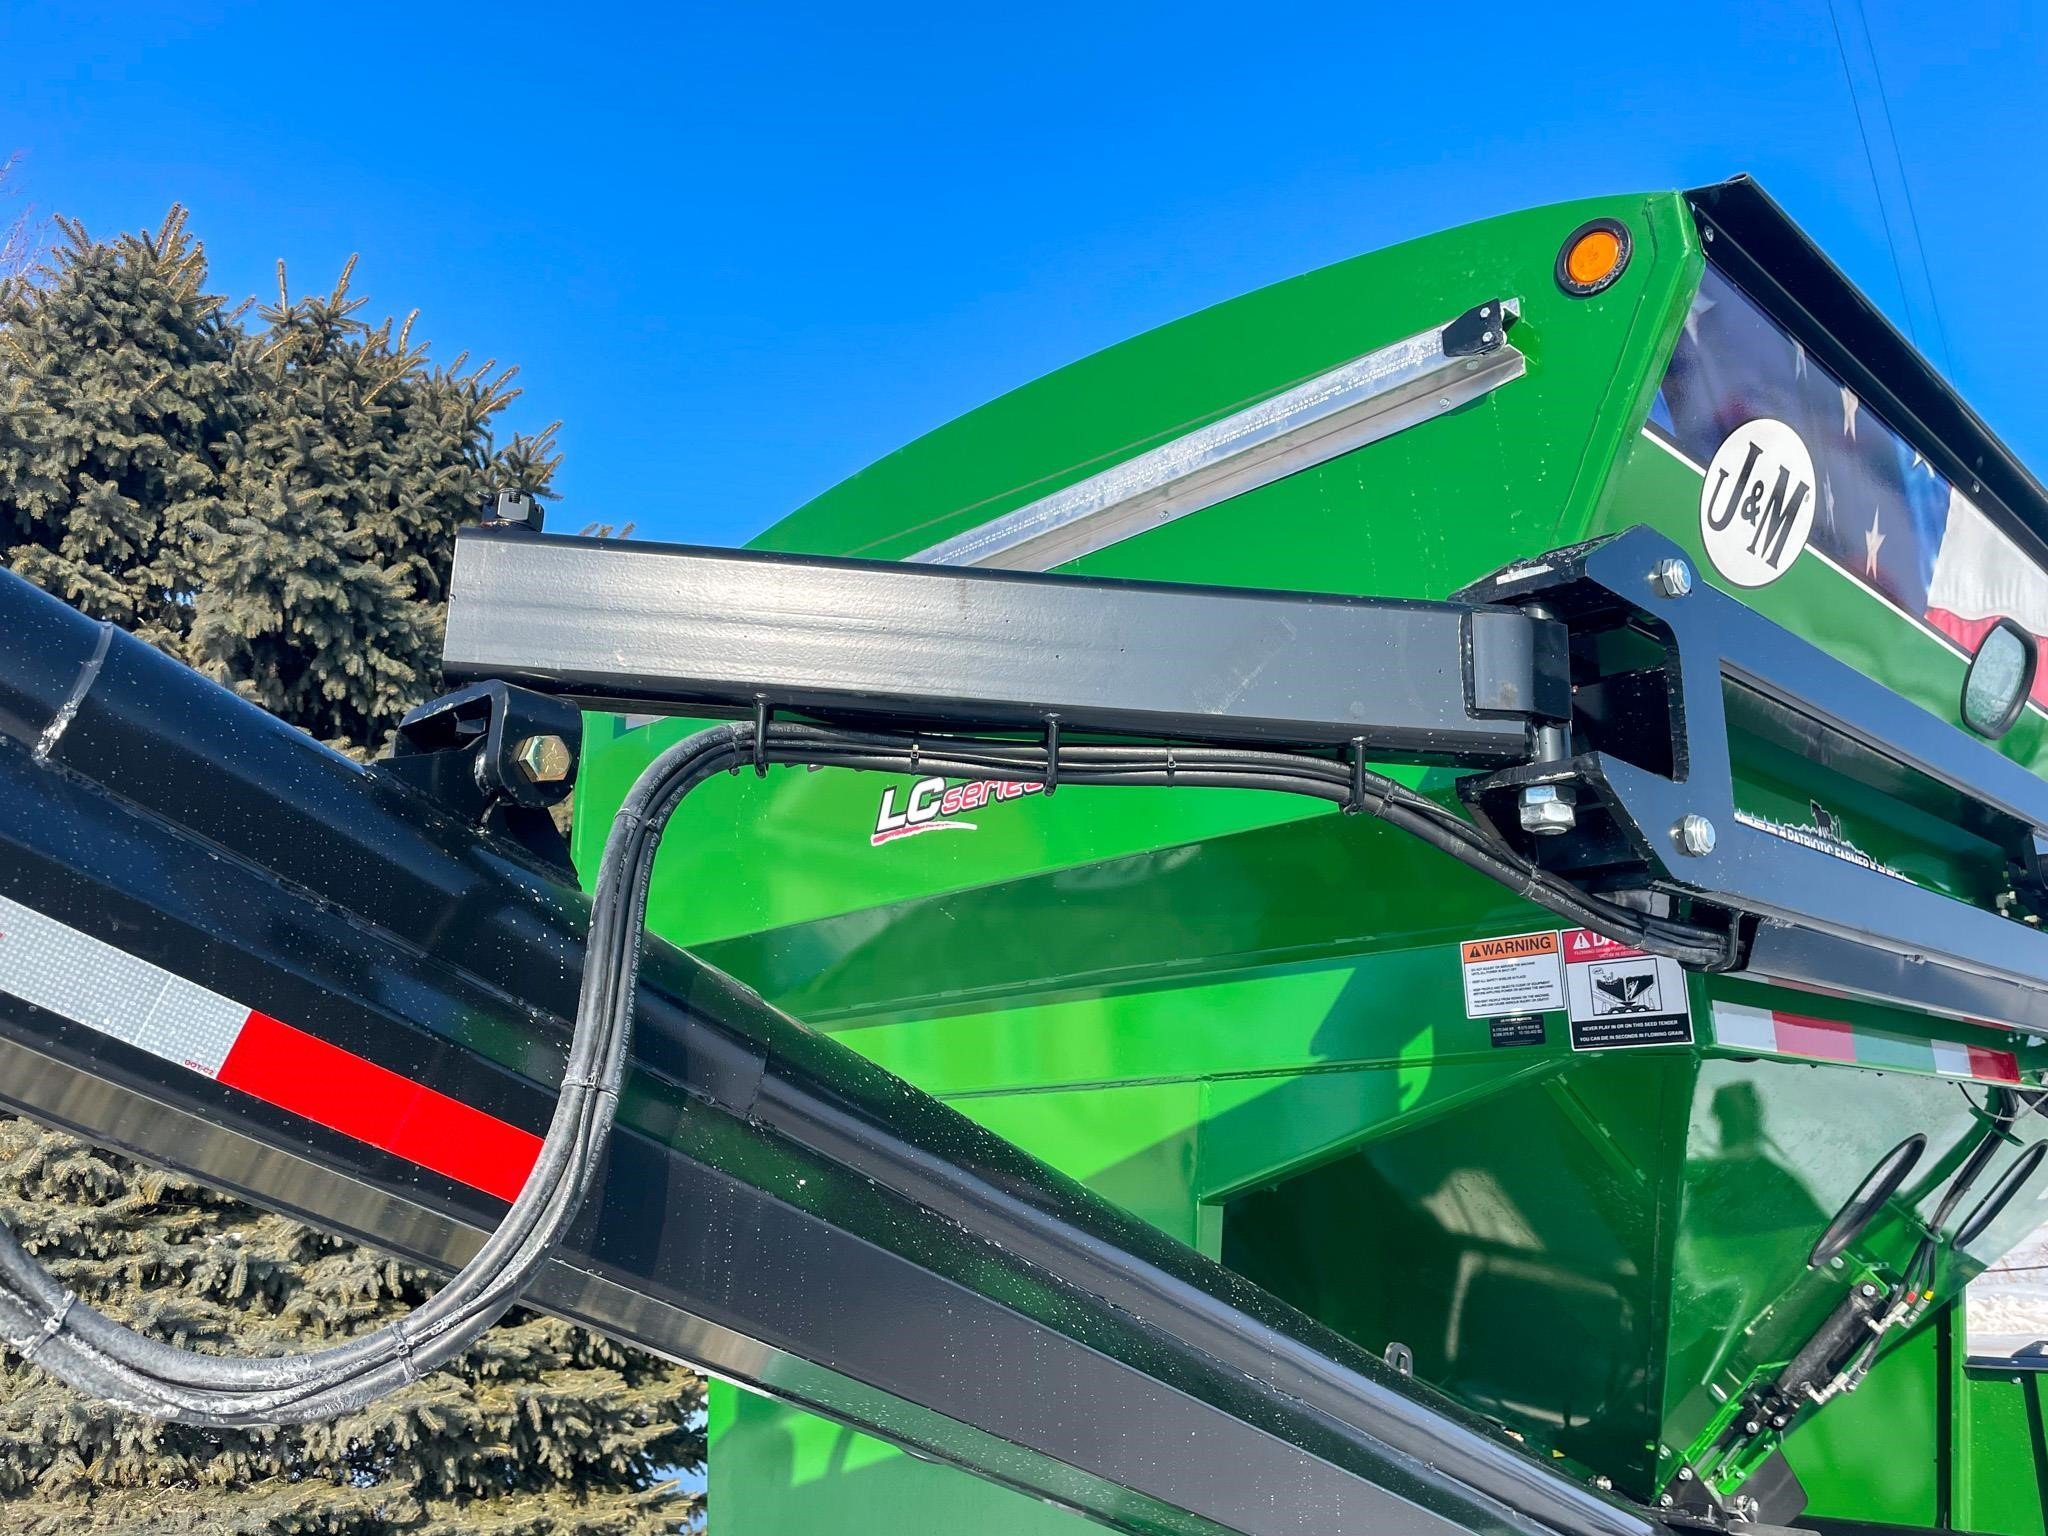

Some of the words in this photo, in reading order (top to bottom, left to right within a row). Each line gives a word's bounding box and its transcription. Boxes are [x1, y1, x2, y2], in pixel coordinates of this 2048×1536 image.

[1707, 441, 1810, 570] J&M
[875, 776, 946, 834] LC
[1482, 937, 1551, 956] WARNING
